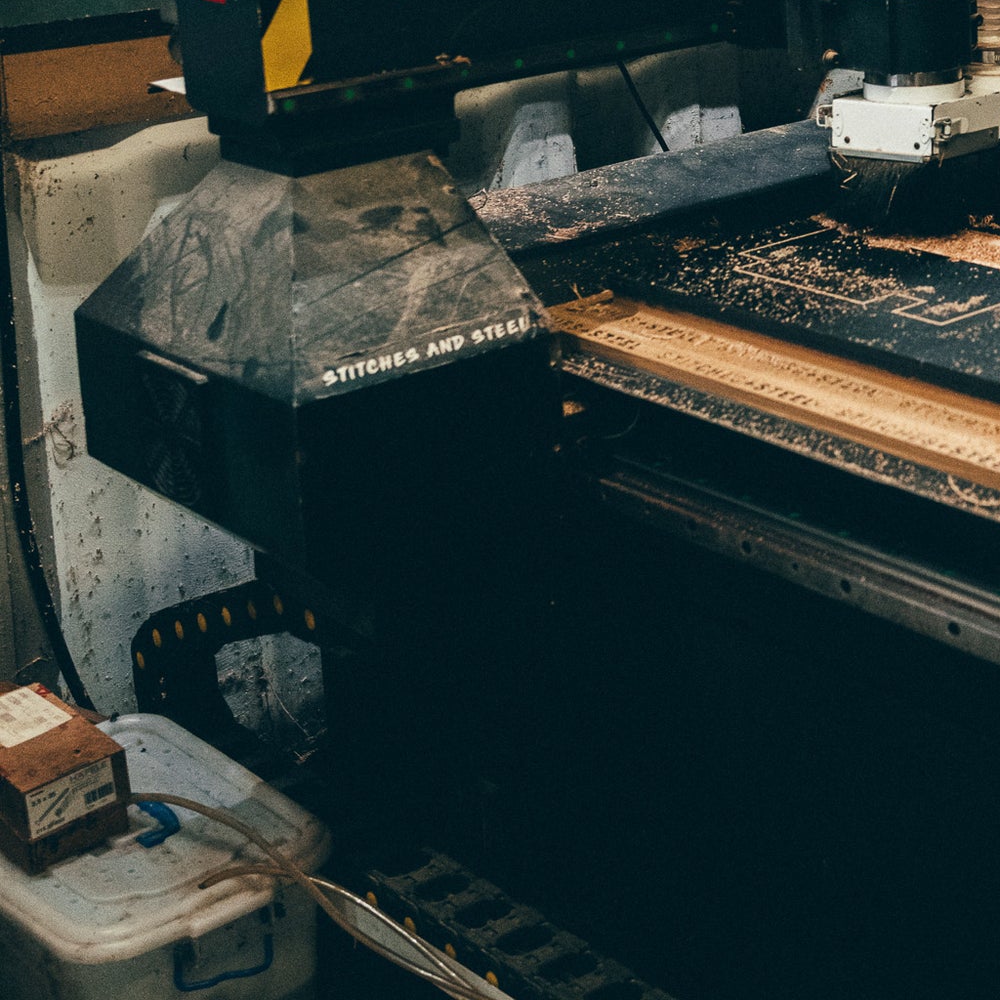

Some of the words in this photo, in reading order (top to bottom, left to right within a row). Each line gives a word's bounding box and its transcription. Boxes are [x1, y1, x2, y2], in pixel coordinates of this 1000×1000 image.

[322, 347, 420, 387] STITCHES
[426, 335, 465, 358] AND
[471, 317, 529, 345] STEEL
